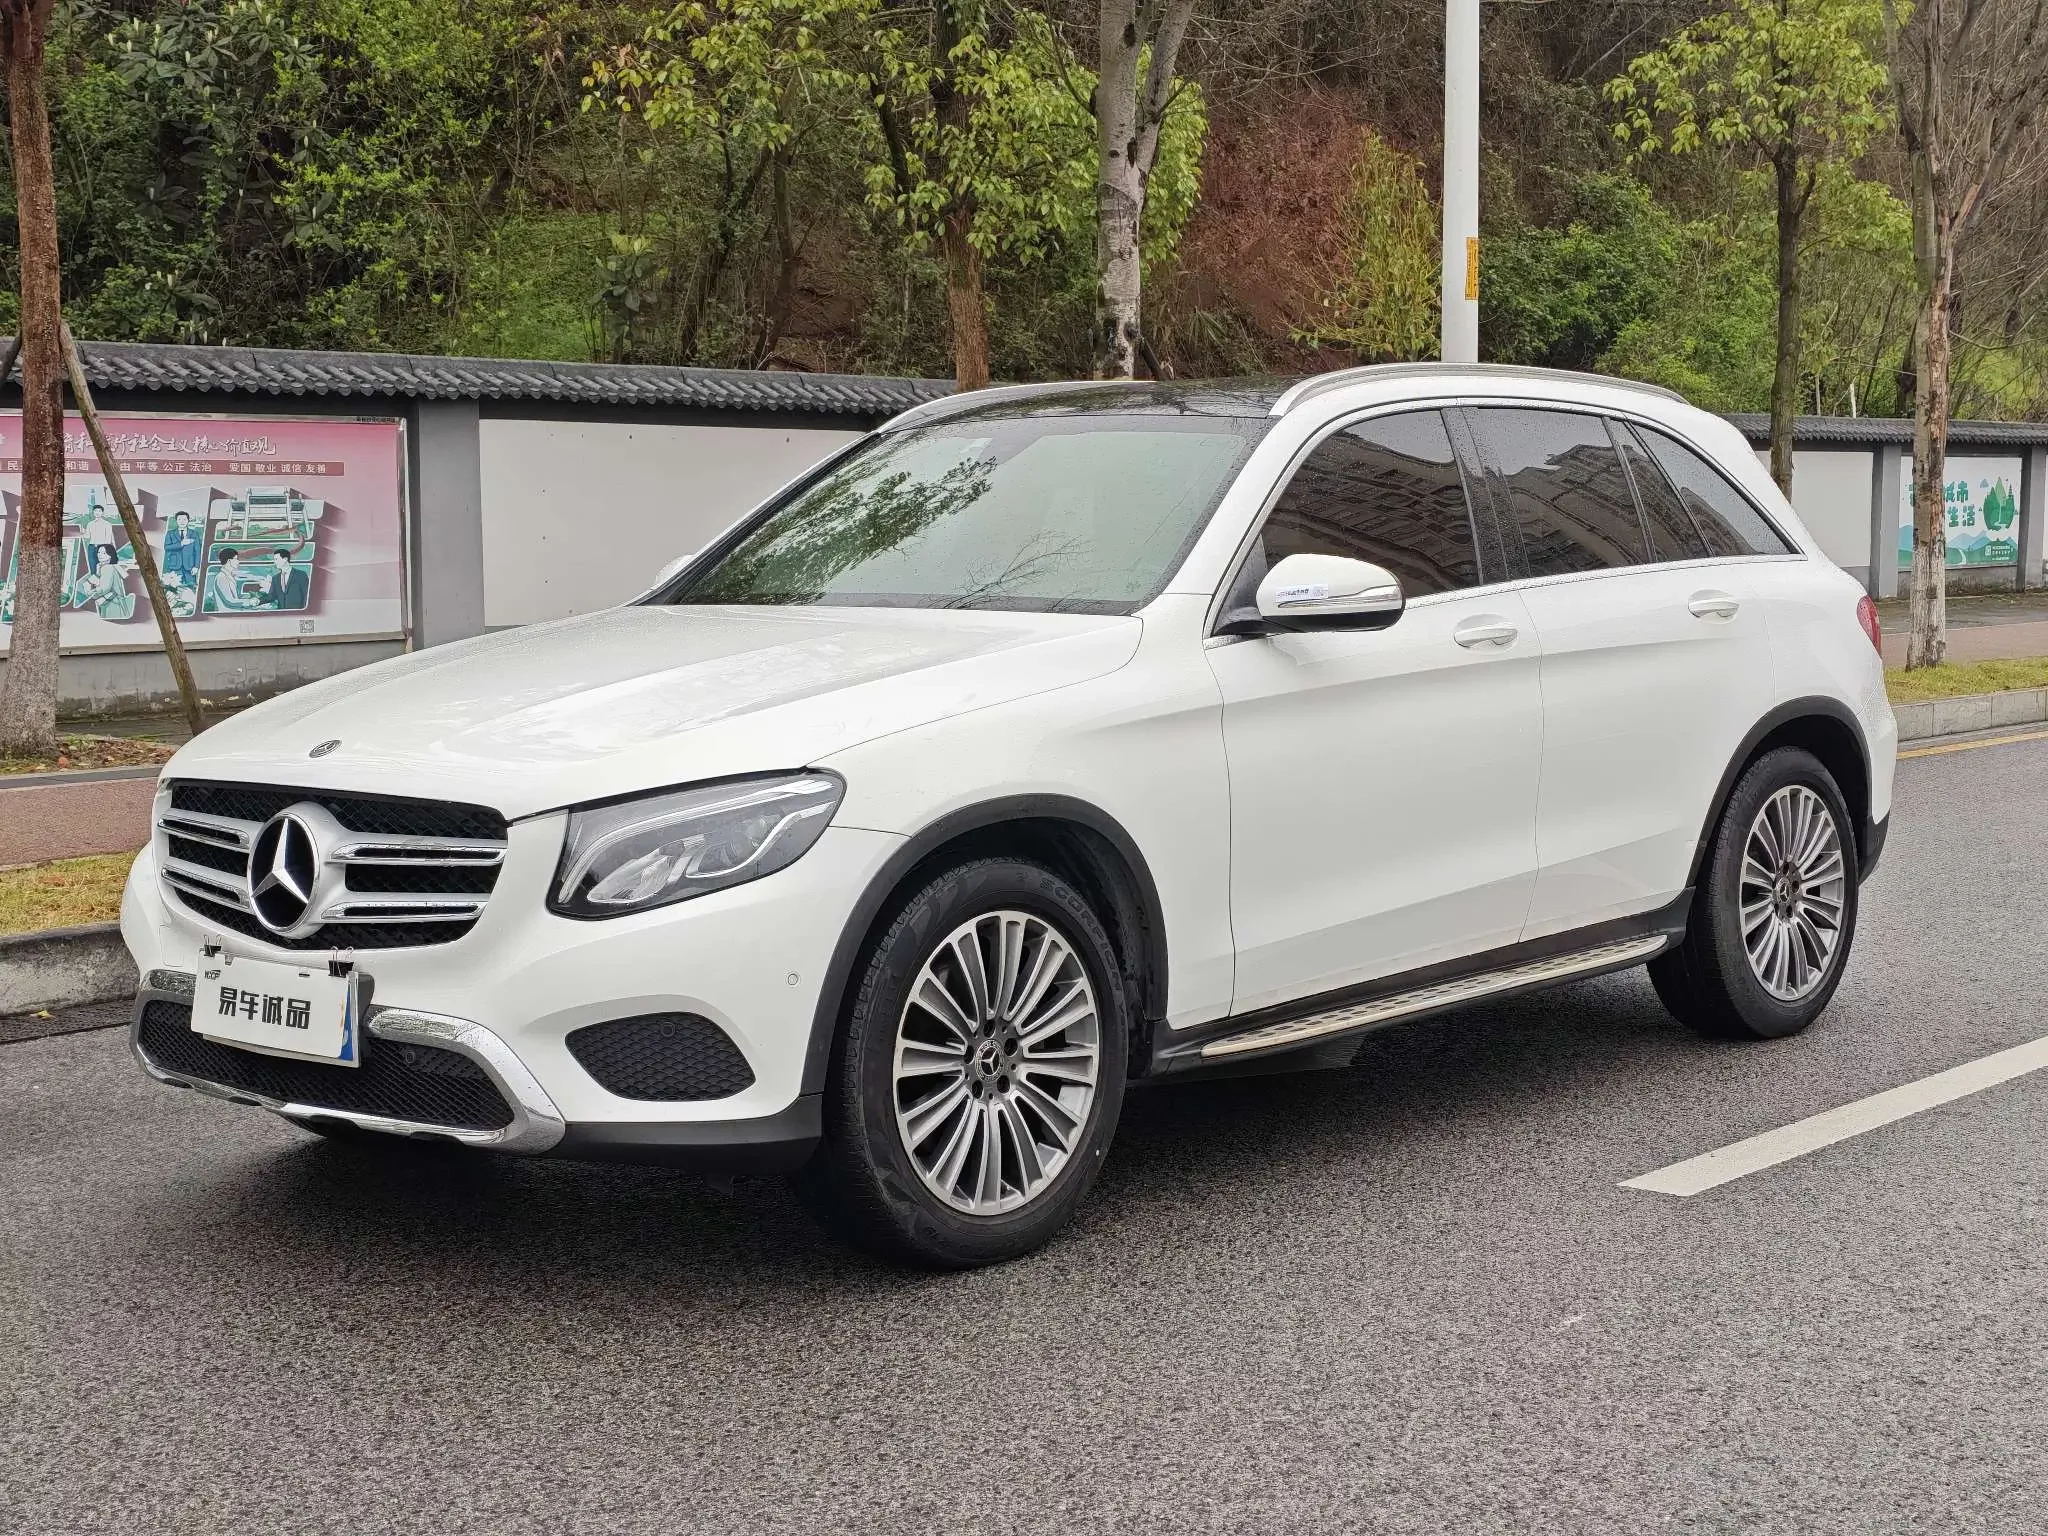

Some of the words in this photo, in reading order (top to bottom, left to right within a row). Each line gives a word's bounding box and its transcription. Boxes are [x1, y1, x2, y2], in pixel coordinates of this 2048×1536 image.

[63, 431, 277, 457] 育和行社会主义核心价值观
[136, 461, 158, 473] 平等
[163, 462, 185, 473] 公正
[190, 462, 212, 473] 法治
[229, 462, 251, 473] 爱国
[255, 463, 277, 473] 敬业
[281, 463, 302, 474] 诚信
[305, 463, 327, 474] 友善
[1947, 504, 1976, 528] 生活
[218, 985, 312, 1031] 易车诚品
